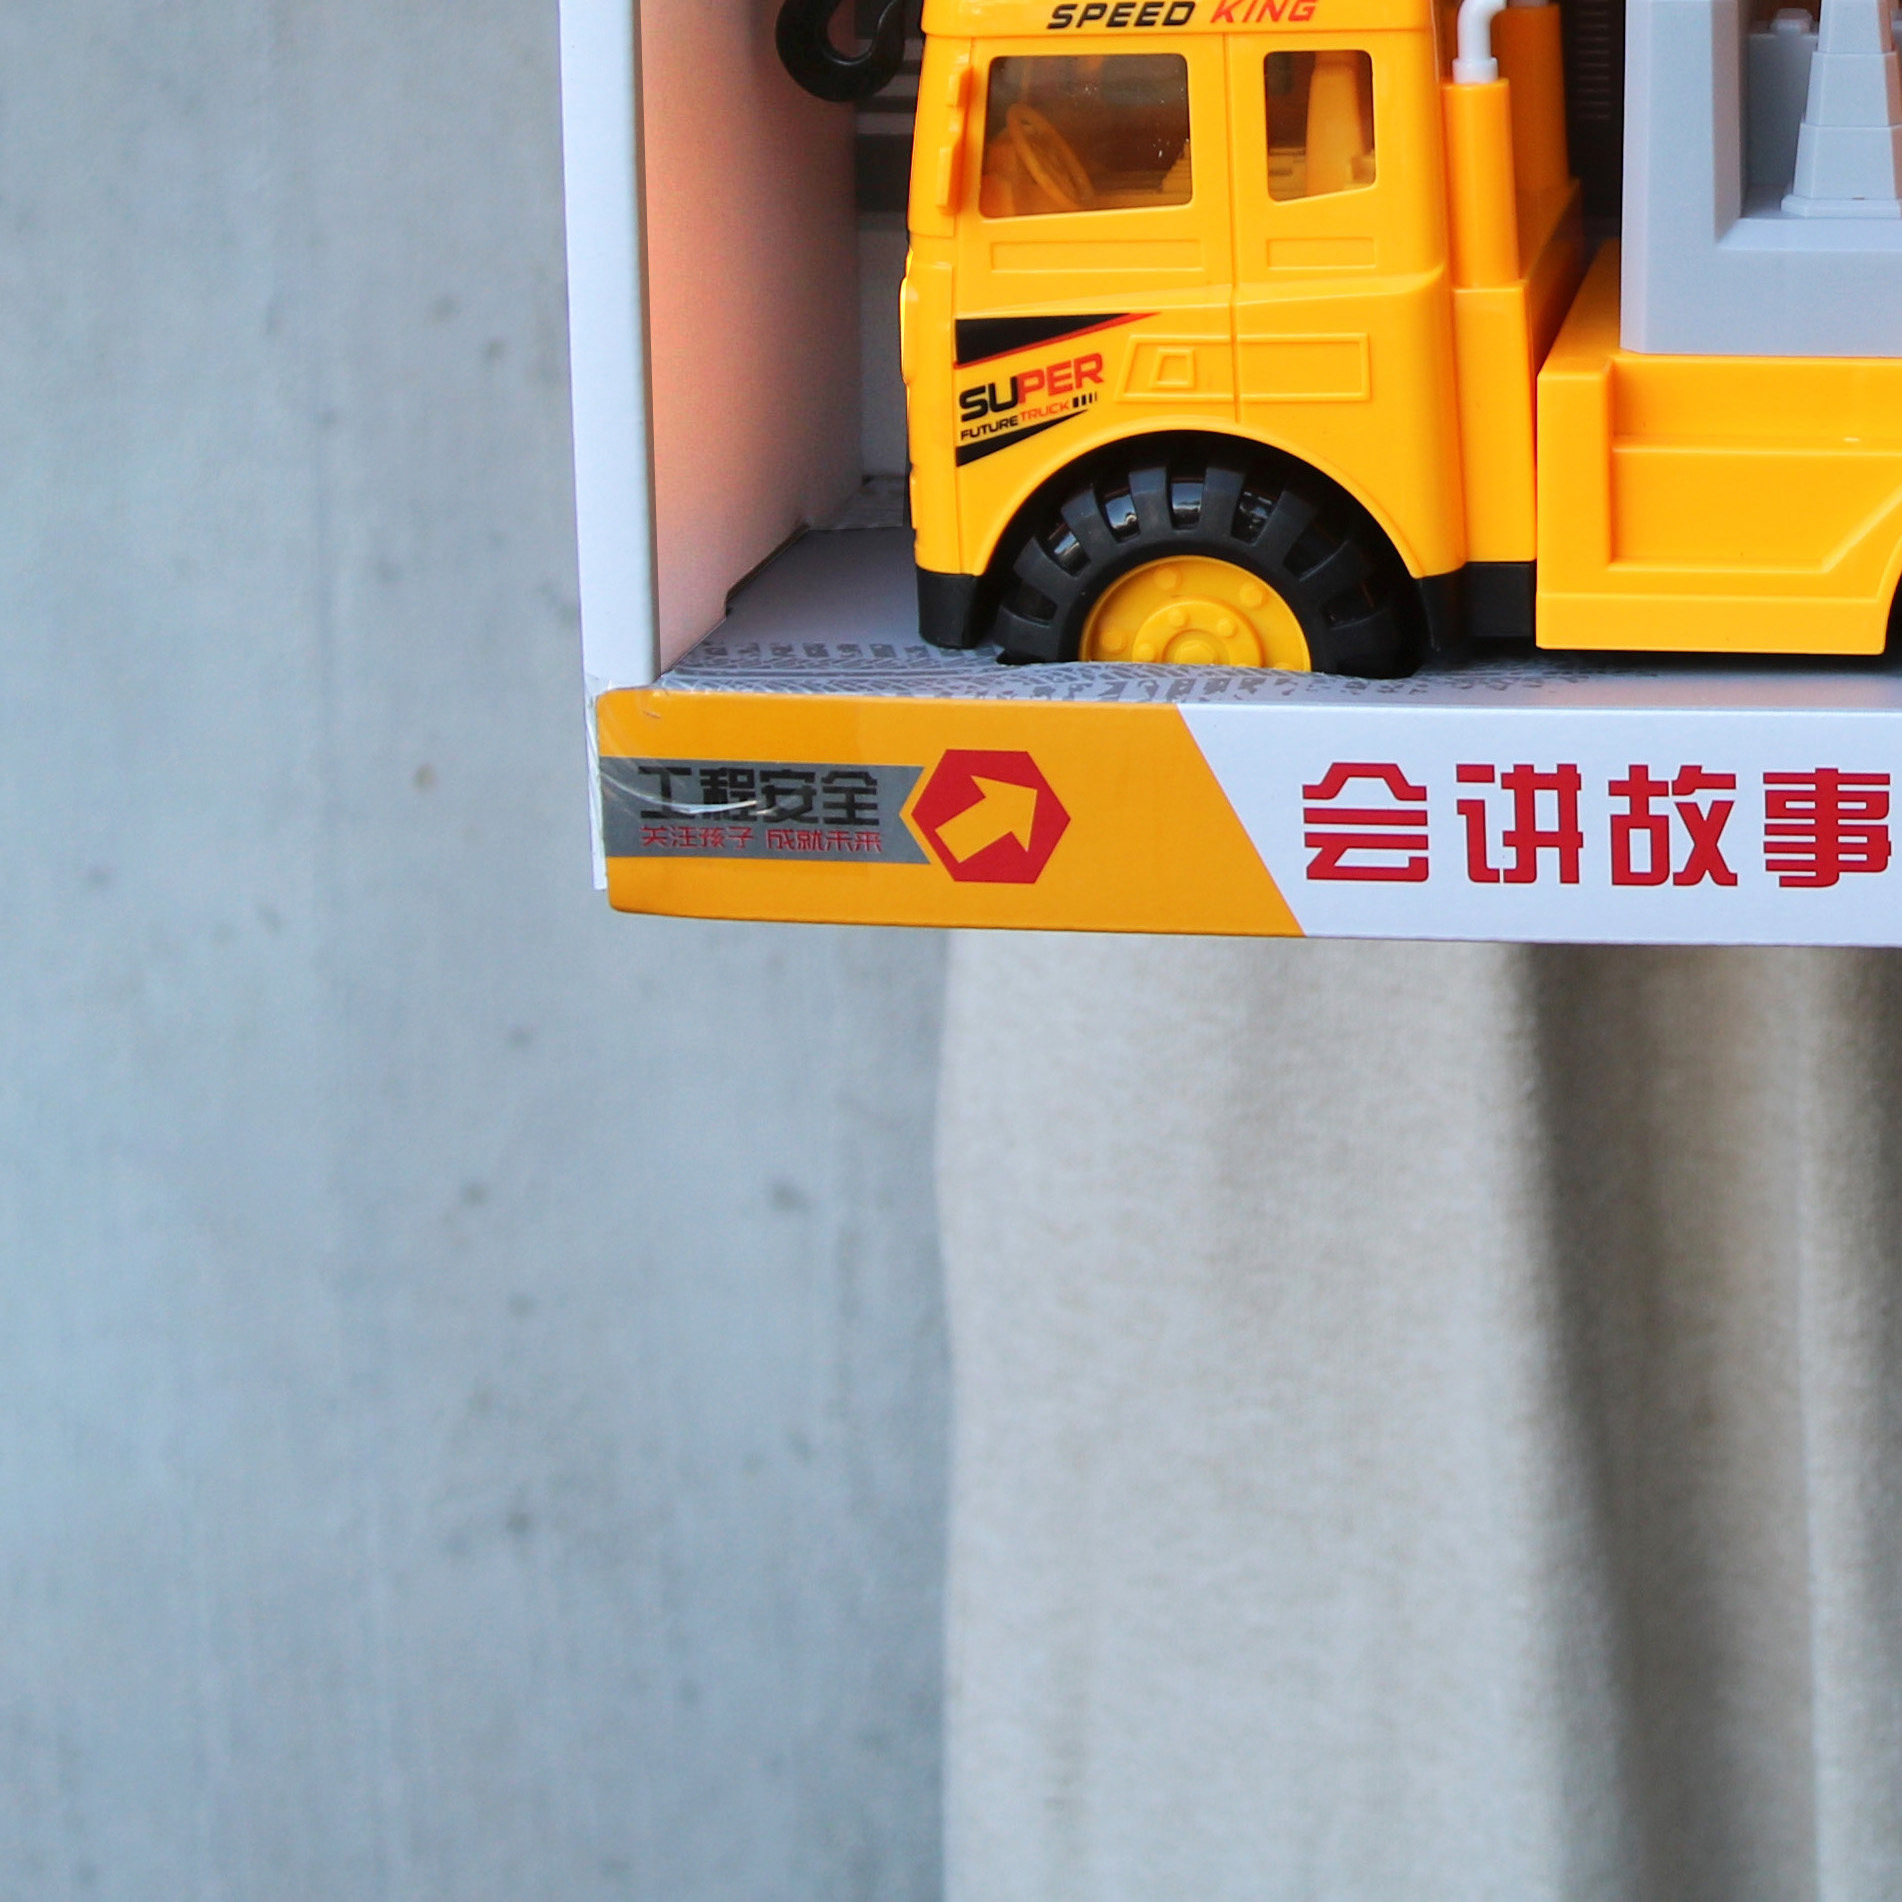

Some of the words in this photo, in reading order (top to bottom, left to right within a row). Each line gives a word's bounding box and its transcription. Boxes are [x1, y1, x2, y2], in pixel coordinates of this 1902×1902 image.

[1046, 0, 1196, 30] SPEED
[959, 352, 1104, 423] SUPER
[960, 414, 1019, 441] FUTURE
[1019, 400, 1070, 422] TRUCK
[637, 765, 880, 826] 工程安全
[640, 824, 754, 849] 关注孩子
[765, 828, 883, 853] 成就未来
